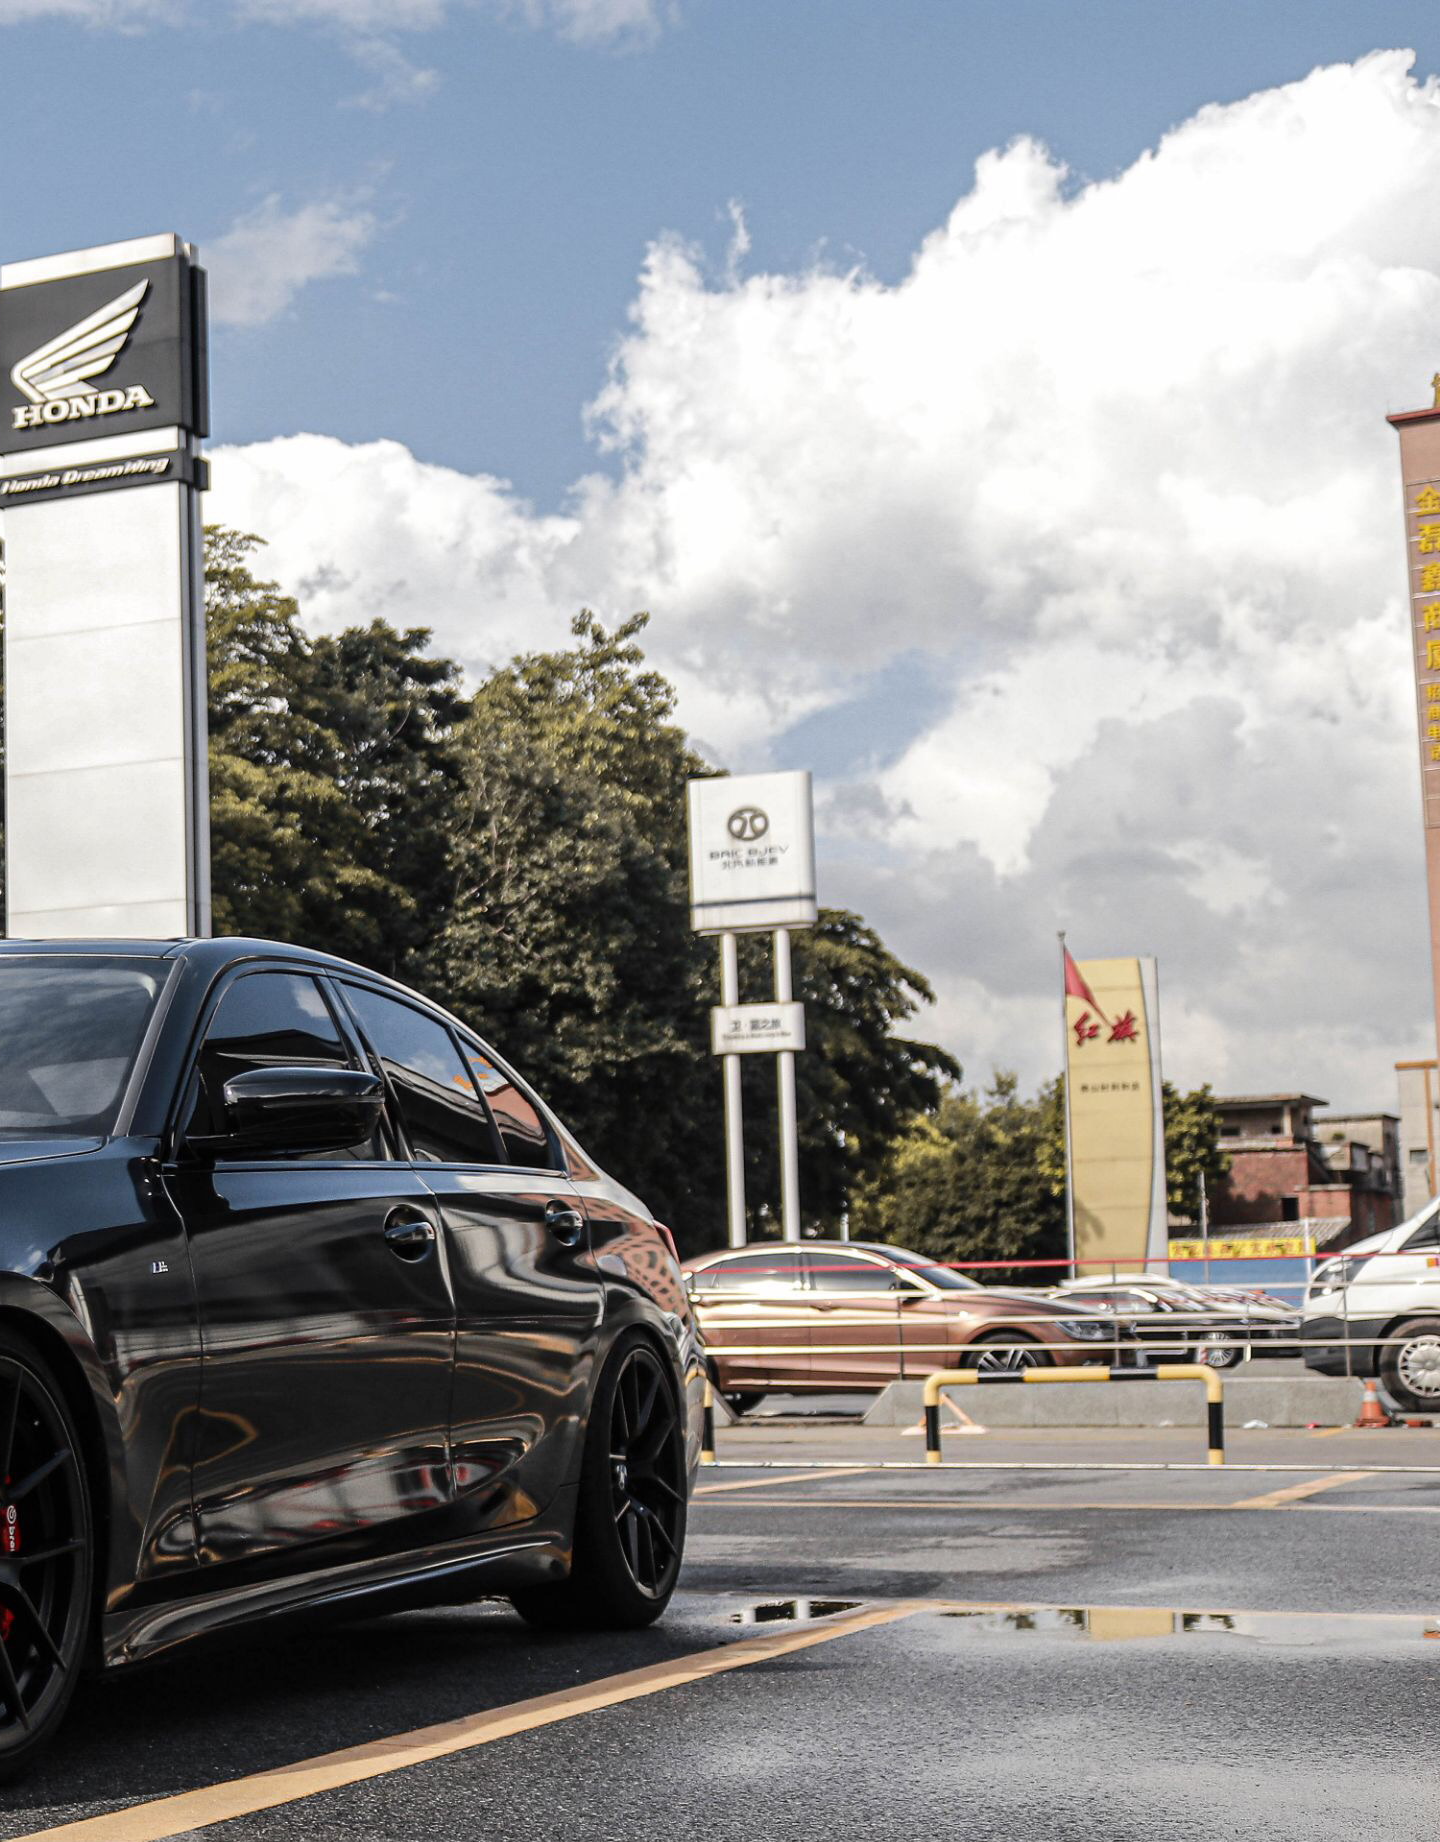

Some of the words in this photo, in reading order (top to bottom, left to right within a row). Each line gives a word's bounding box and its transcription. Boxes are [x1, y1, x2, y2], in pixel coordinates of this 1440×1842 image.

[12, 384, 154, 429] HONDA
[0, 474, 60, 494] Honda
[1073, 1010, 1139, 1047] 红旗
